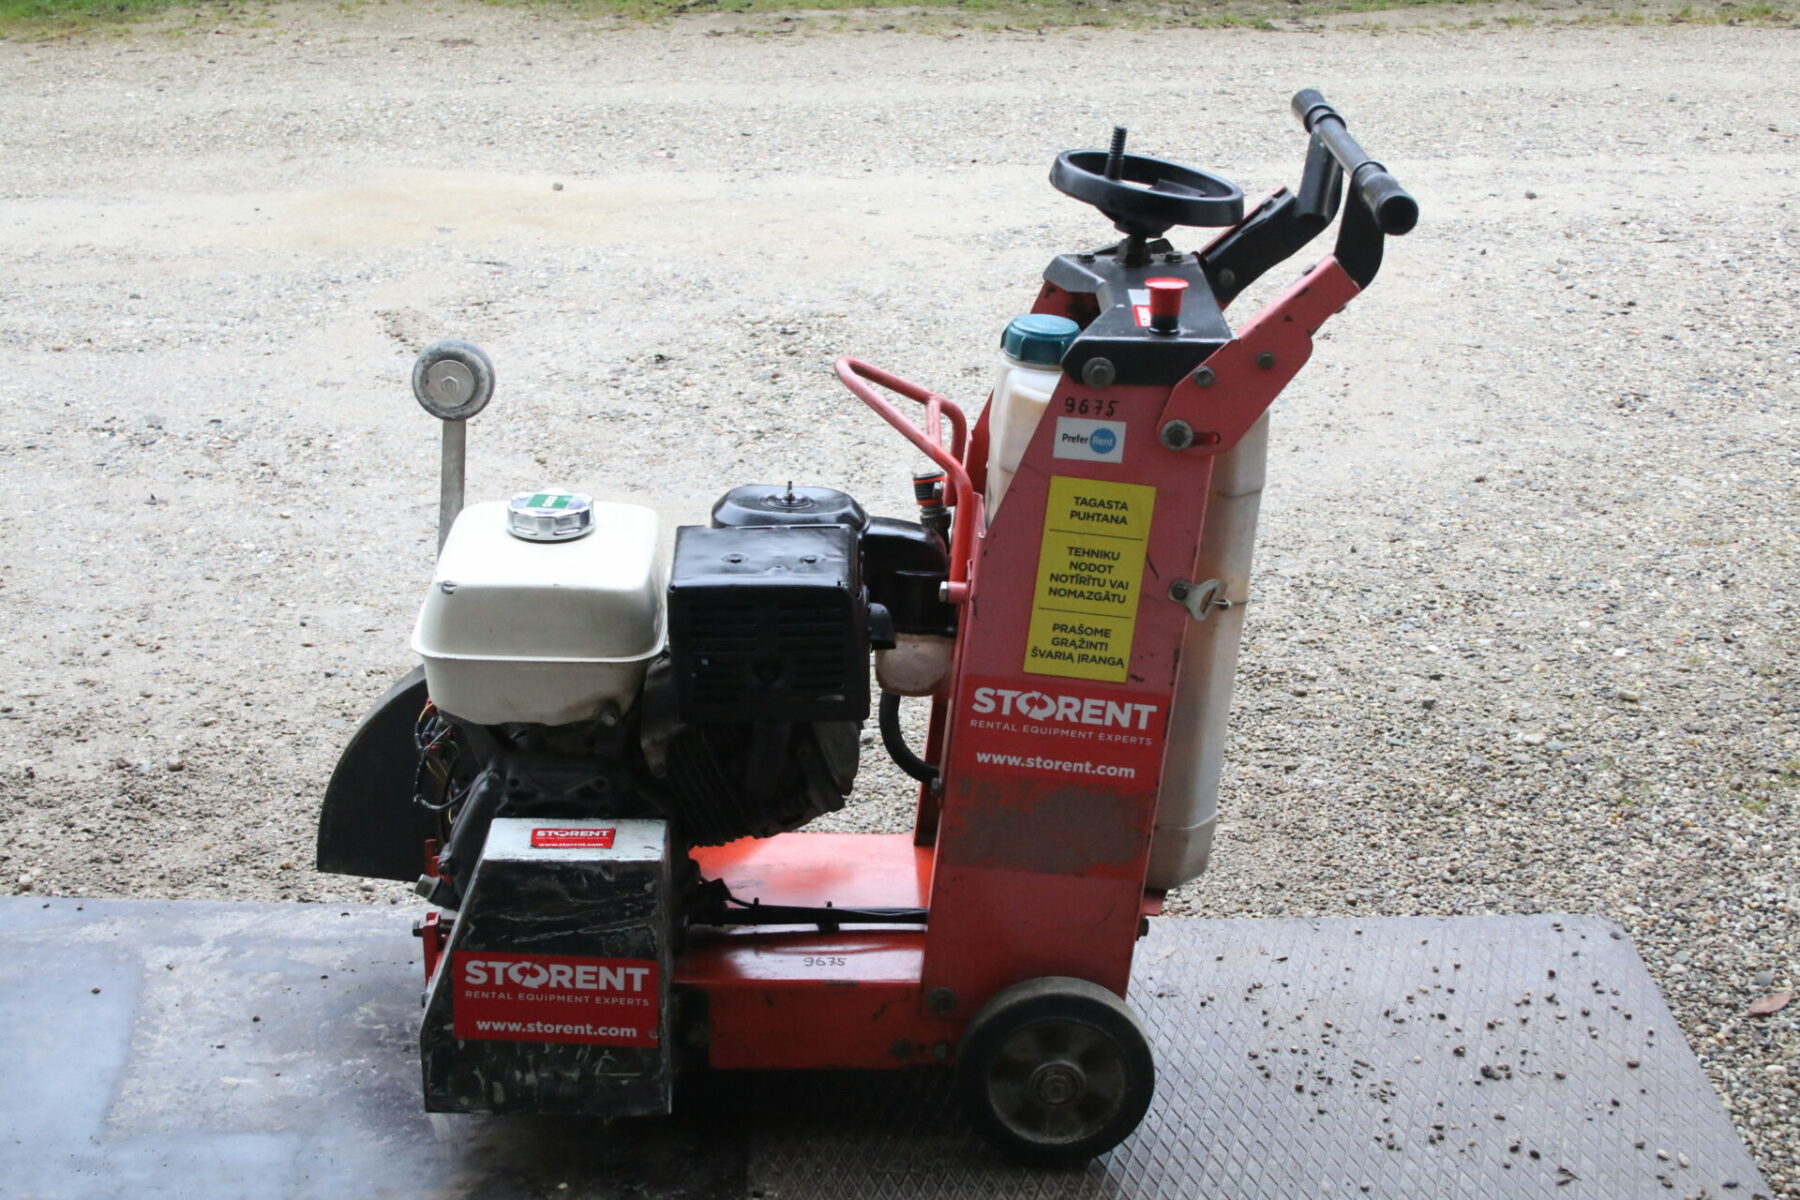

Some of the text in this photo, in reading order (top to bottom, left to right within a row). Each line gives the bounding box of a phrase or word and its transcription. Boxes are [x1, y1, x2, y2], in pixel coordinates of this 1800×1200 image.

[1065, 397, 1119, 417] 9675
[1062, 433, 1113, 445] Prefer Rent
[1073, 496, 1129, 511] TAGASTA
[1070, 510, 1128, 525] PUHTANA
[1067, 546, 1120, 561] TEHNIKU
[1069, 560, 1114, 574] NODOT
[1050, 573, 1129, 590] NOTĪRĪTU VAI
[1048, 587, 1126, 603] NOMAZGĀTU
[1052, 623, 1111, 638] PRAŠOME
[1051, 637, 1108, 651] GRĄŽINTI
[1031, 646, 1124, 668] ŠVARIĄ ĮRANGĄ
[972, 687, 1157, 730] STORENT
[970, 719, 1152, 746] RENTAL EQUIPMENT EXPERTS
[976, 752, 1136, 778] www.storent.com
[803, 957, 847, 967] 9675
[465, 960, 649, 991] STORENT
[465, 990, 649, 1006] RENTAL EQUIPMENT EXPERTS
[476, 1020, 637, 1037] www.storent.com
